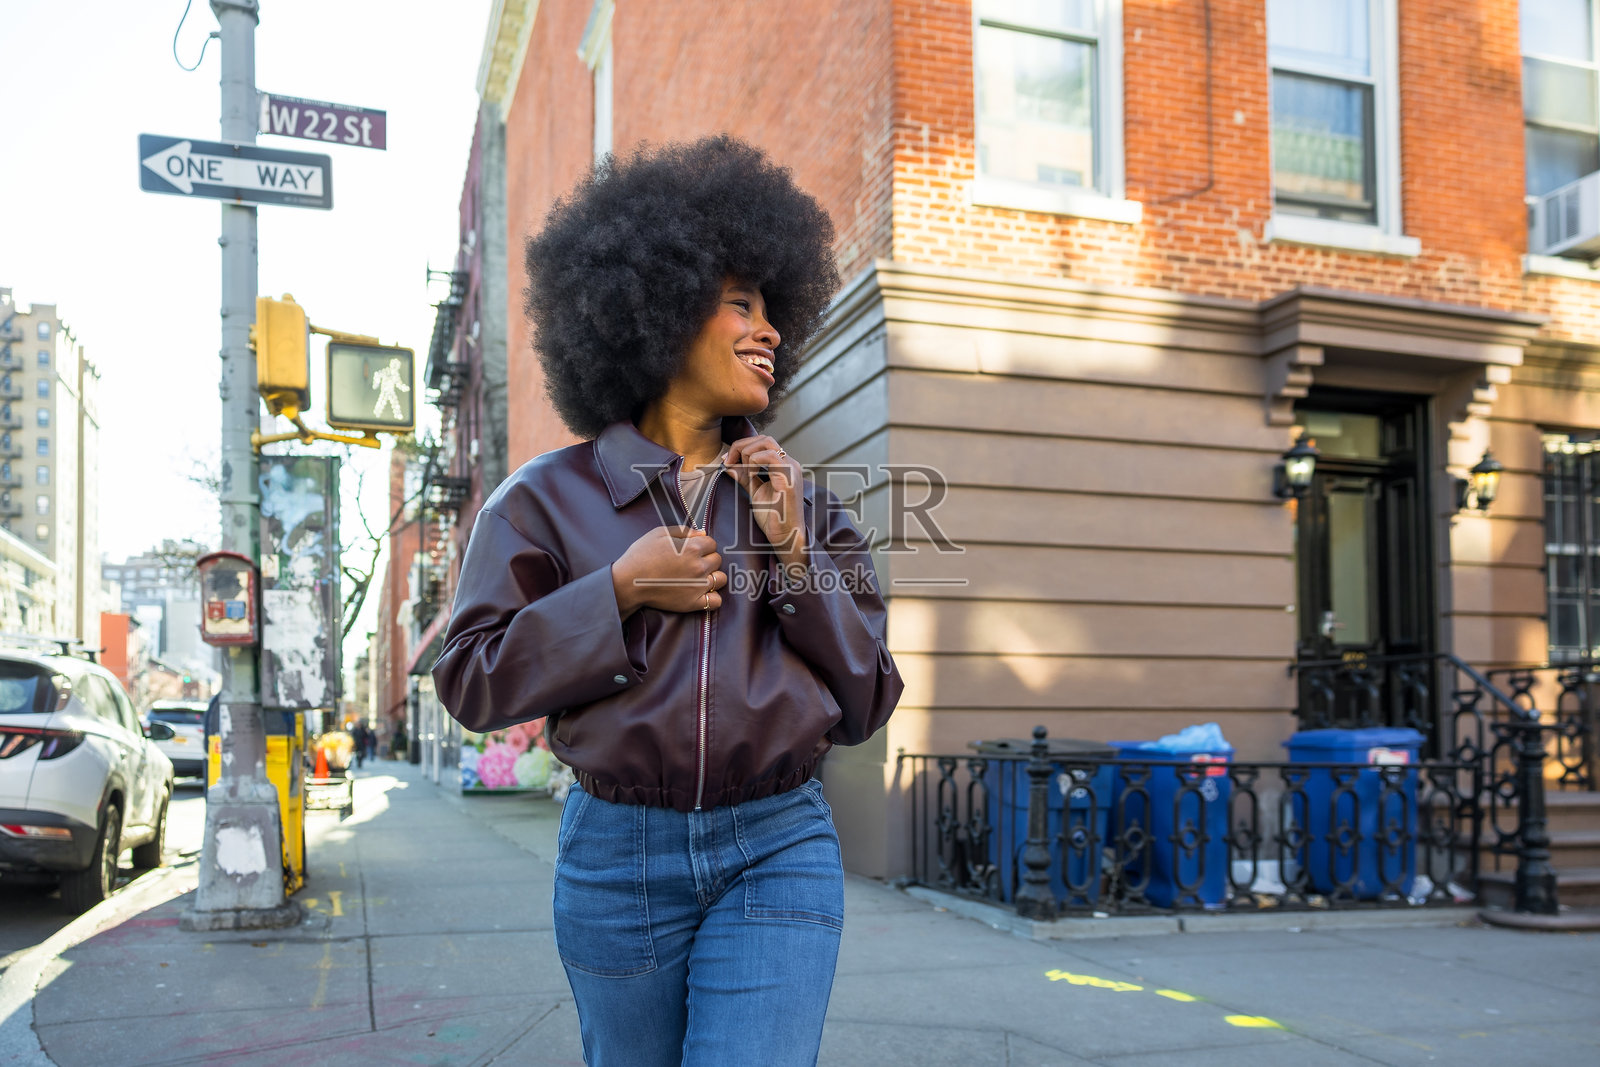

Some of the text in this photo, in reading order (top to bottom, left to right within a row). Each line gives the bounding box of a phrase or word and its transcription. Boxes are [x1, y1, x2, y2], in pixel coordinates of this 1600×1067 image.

[271, 104, 373, 146] W 22 St
[166, 155, 315, 190] ONE WAY
